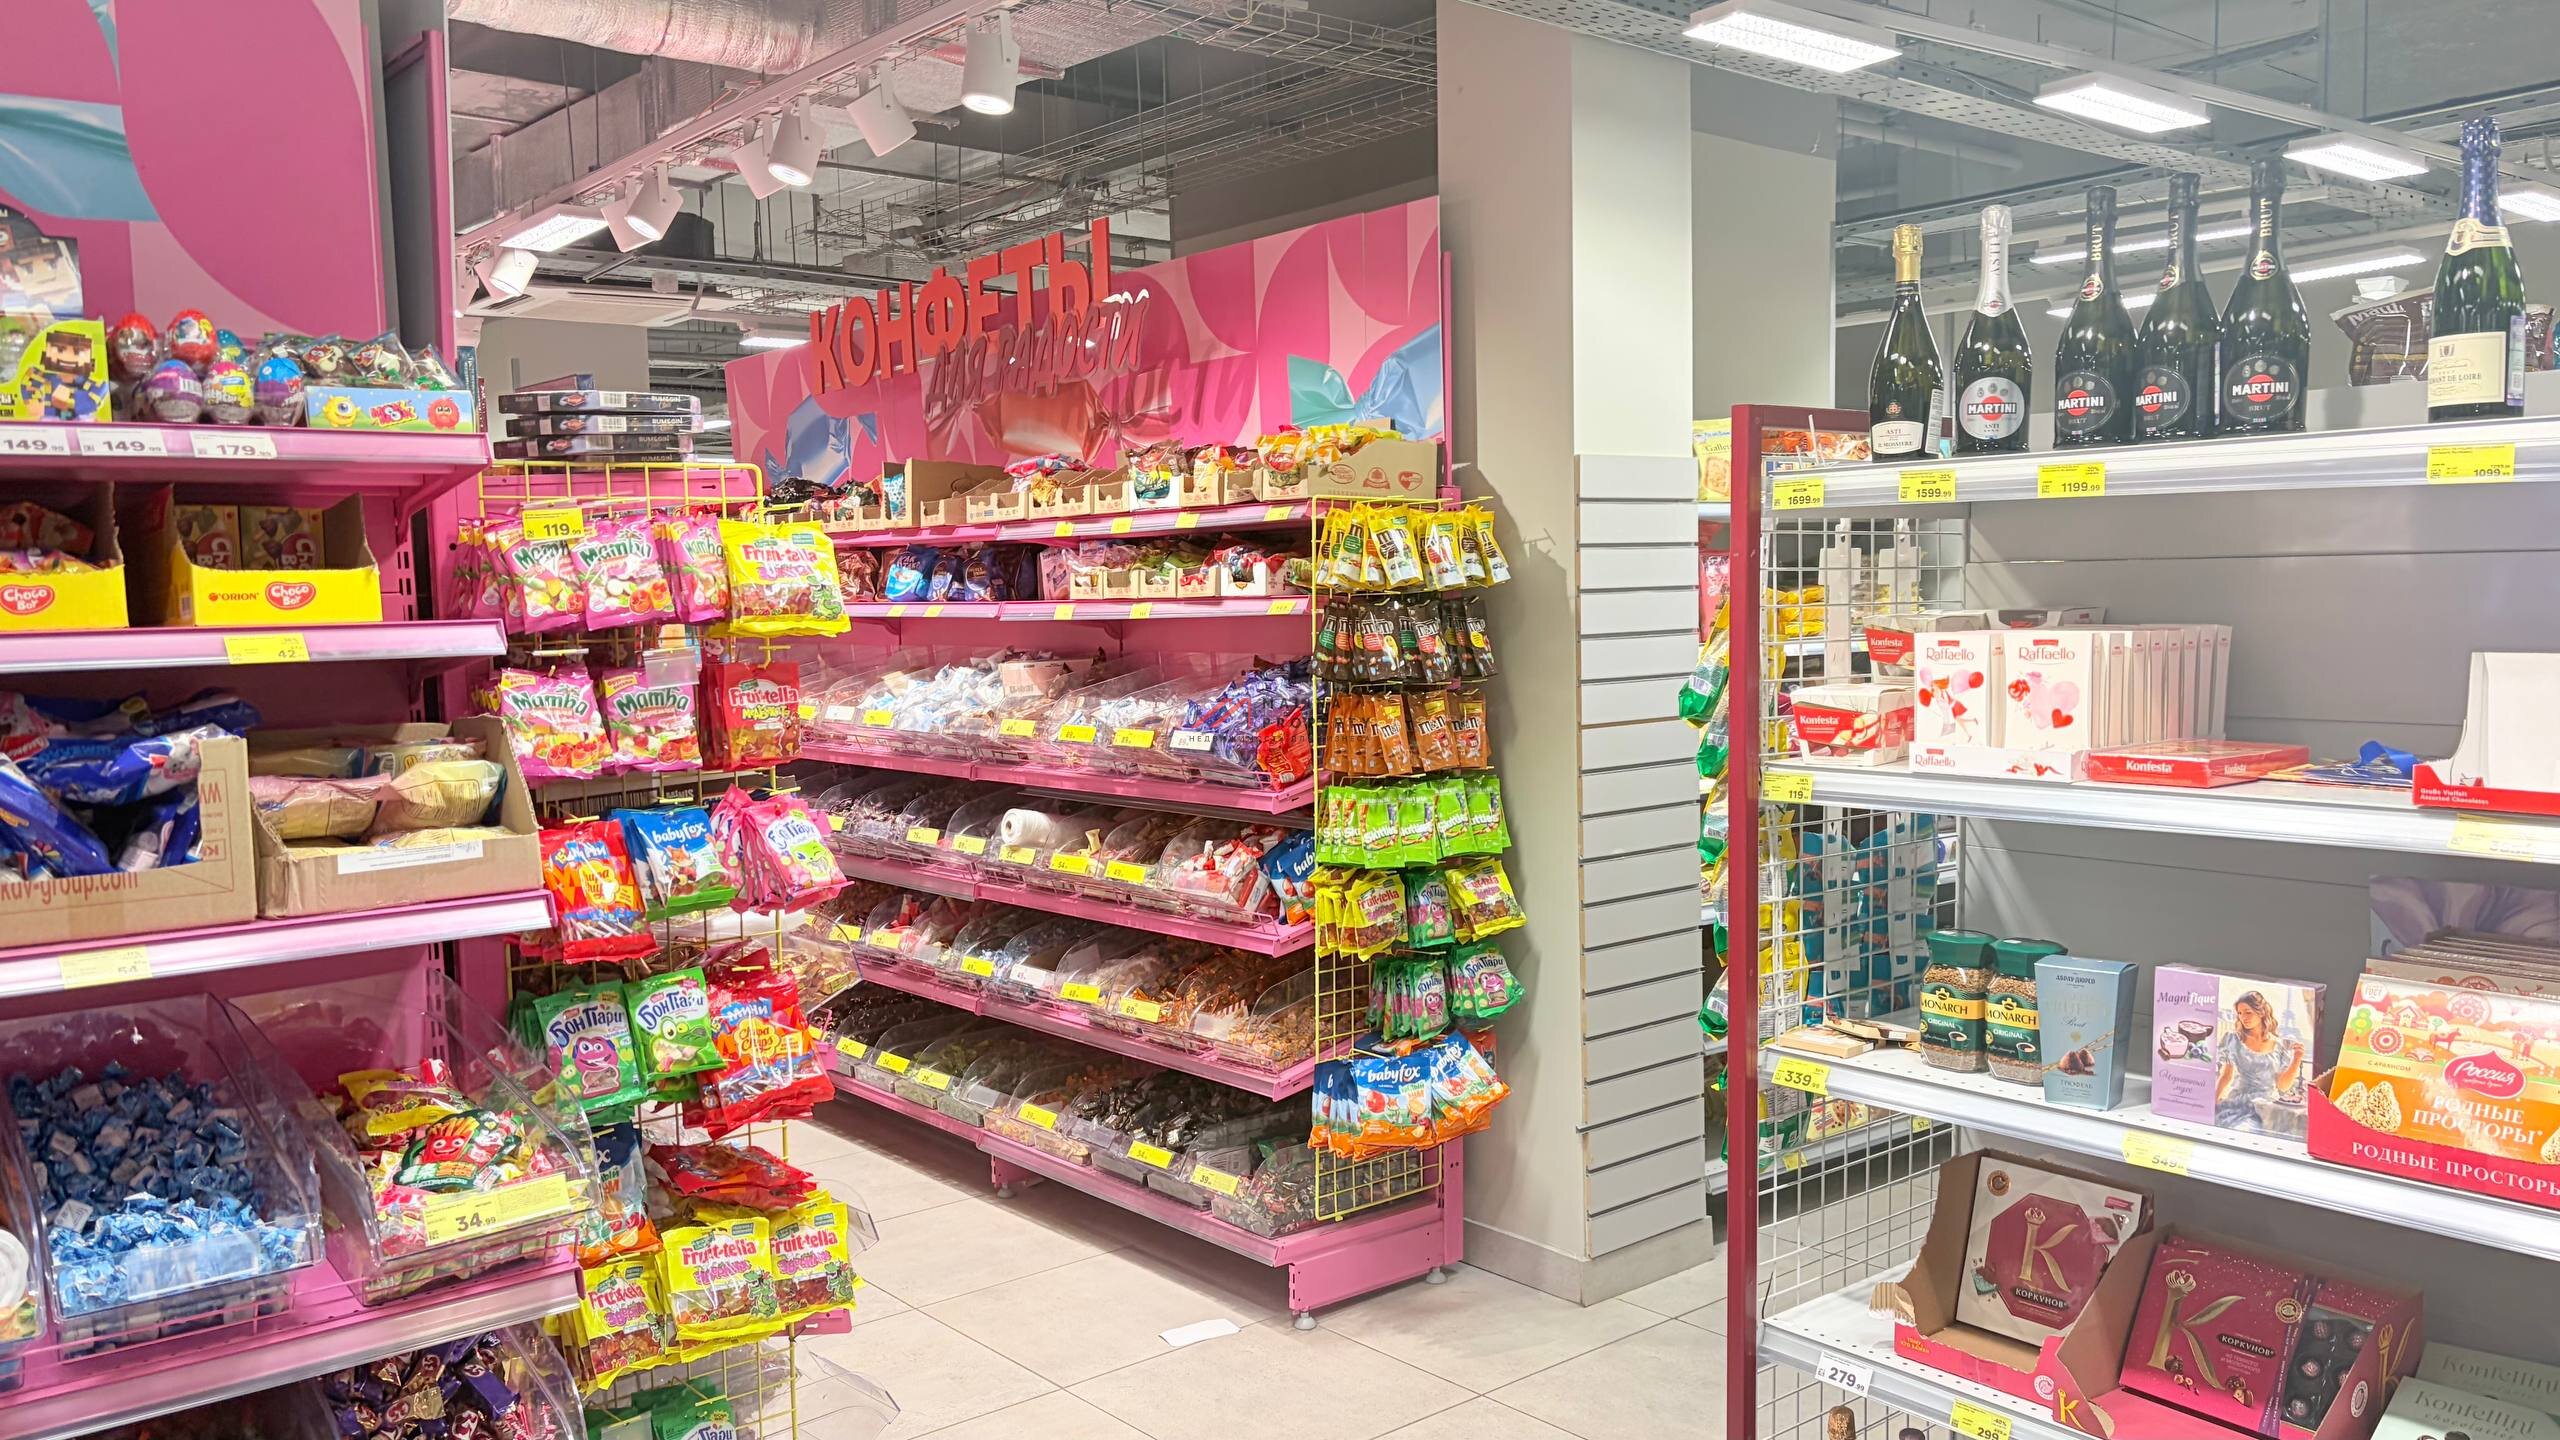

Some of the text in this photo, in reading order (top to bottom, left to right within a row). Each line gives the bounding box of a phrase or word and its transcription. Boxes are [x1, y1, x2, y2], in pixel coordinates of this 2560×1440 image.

[2258, 198, 2272, 239] BRUT
[2090, 225, 2104, 261] BRUT
[809, 216, 1110, 395] КОНФЕТЫ
[925, 298, 1150, 416] ДЛЯ РАДОСТИ
[2231, 381, 2289, 396] MARTINI
[2058, 395, 2104, 410] MARTINI
[2135, 391, 2178, 407] MARTINI
[1967, 402, 2017, 415] MARTINI
[1916, 488, 1952, 498] 1599.99
[2061, 482, 2101, 493] 1199.99
[543, 523, 582, 537] 119.99
[1, 584, 49, 598] Choco
[270, 583, 311, 597] Choco
[1870, 637, 1903, 648] Konfesta
[1925, 646, 1975, 662] Raffaello
[2018, 646, 2076, 661] Raffaello
[511, 691, 589, 717] Mamba
[615, 690, 692, 717] Mamba
[729, 686, 799, 705] Fruit-tella
[1800, 715, 1839, 726] Konfesta
[1914, 754, 1956, 769] Raffaello
[2125, 759, 2173, 773] Konfesta
[651, 820, 708, 846] babyfox
[1364, 825, 1399, 843] Skittles
[1400, 822, 1434, 836] kittles
[1920, 999, 1969, 1016] MONARCH
[2157, 991, 2216, 1006] Magnifique
[637, 1000, 670, 1030] Бон
[1927, 1017, 1956, 1029] ORIGINAL
[1986, 1009, 2037, 1026] MONARCH
[550, 1007, 625, 1047] Бон Пари
[738, 1025, 771, 1043] Chupa
[1993, 1029, 2025, 1040] ORIGINAL
[740, 1035, 775, 1054] Chups
[1367, 1063, 1421, 1083] babyfox
[2452, 1060, 2517, 1086] Россия
[2432, 1094, 2524, 1125] РОДНЫЕ
[2412, 1108, 2538, 1146] ПРОСТОРЫ
[2351, 1141, 2440, 1173] РОДНЫЕ
[455, 1211, 497, 1232] 34.99
[770, 1228, 839, 1255] Fruit-tella
[682, 1239, 759, 1266] Fruit-tella
[1828, 1367, 1865, 1392] 279.99
